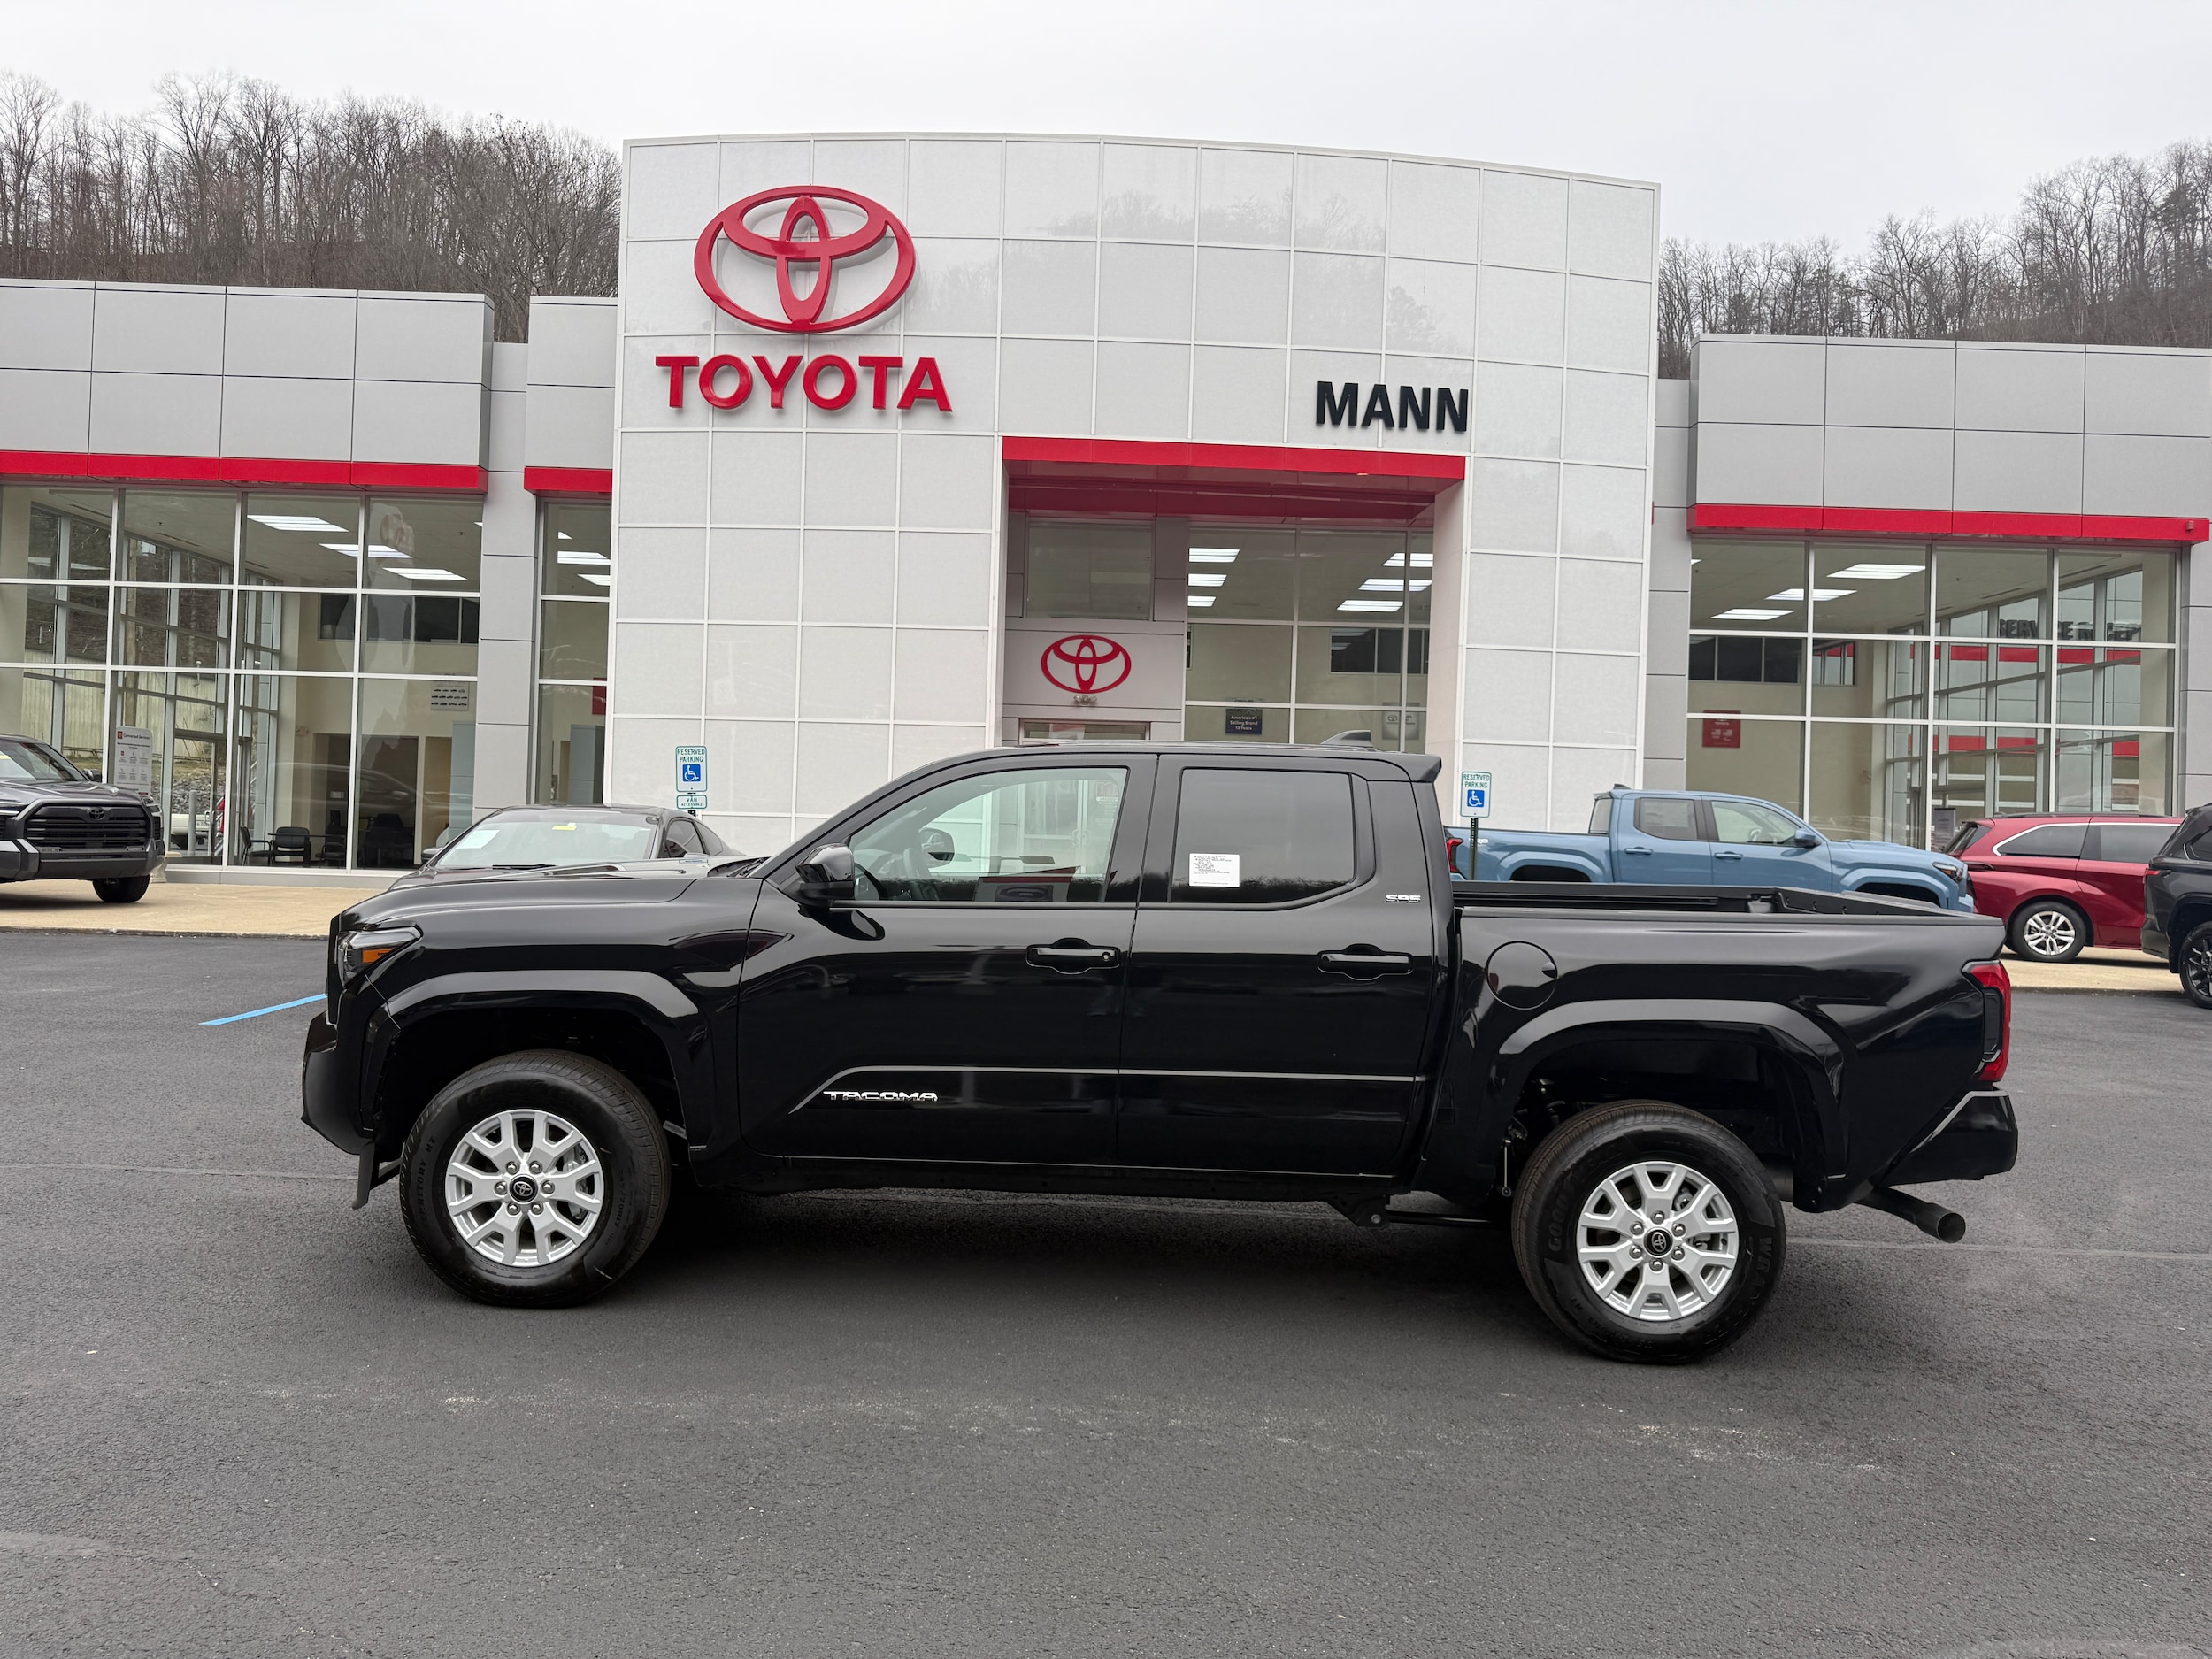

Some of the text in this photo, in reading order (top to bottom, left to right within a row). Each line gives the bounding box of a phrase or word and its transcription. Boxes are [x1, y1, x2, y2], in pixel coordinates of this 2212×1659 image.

[655, 354, 953, 412] TOYOTA
[1316, 380, 1469, 432] MANN
[1386, 894, 1422, 902] SR5
[823, 1090, 938, 1102] TACOMA
